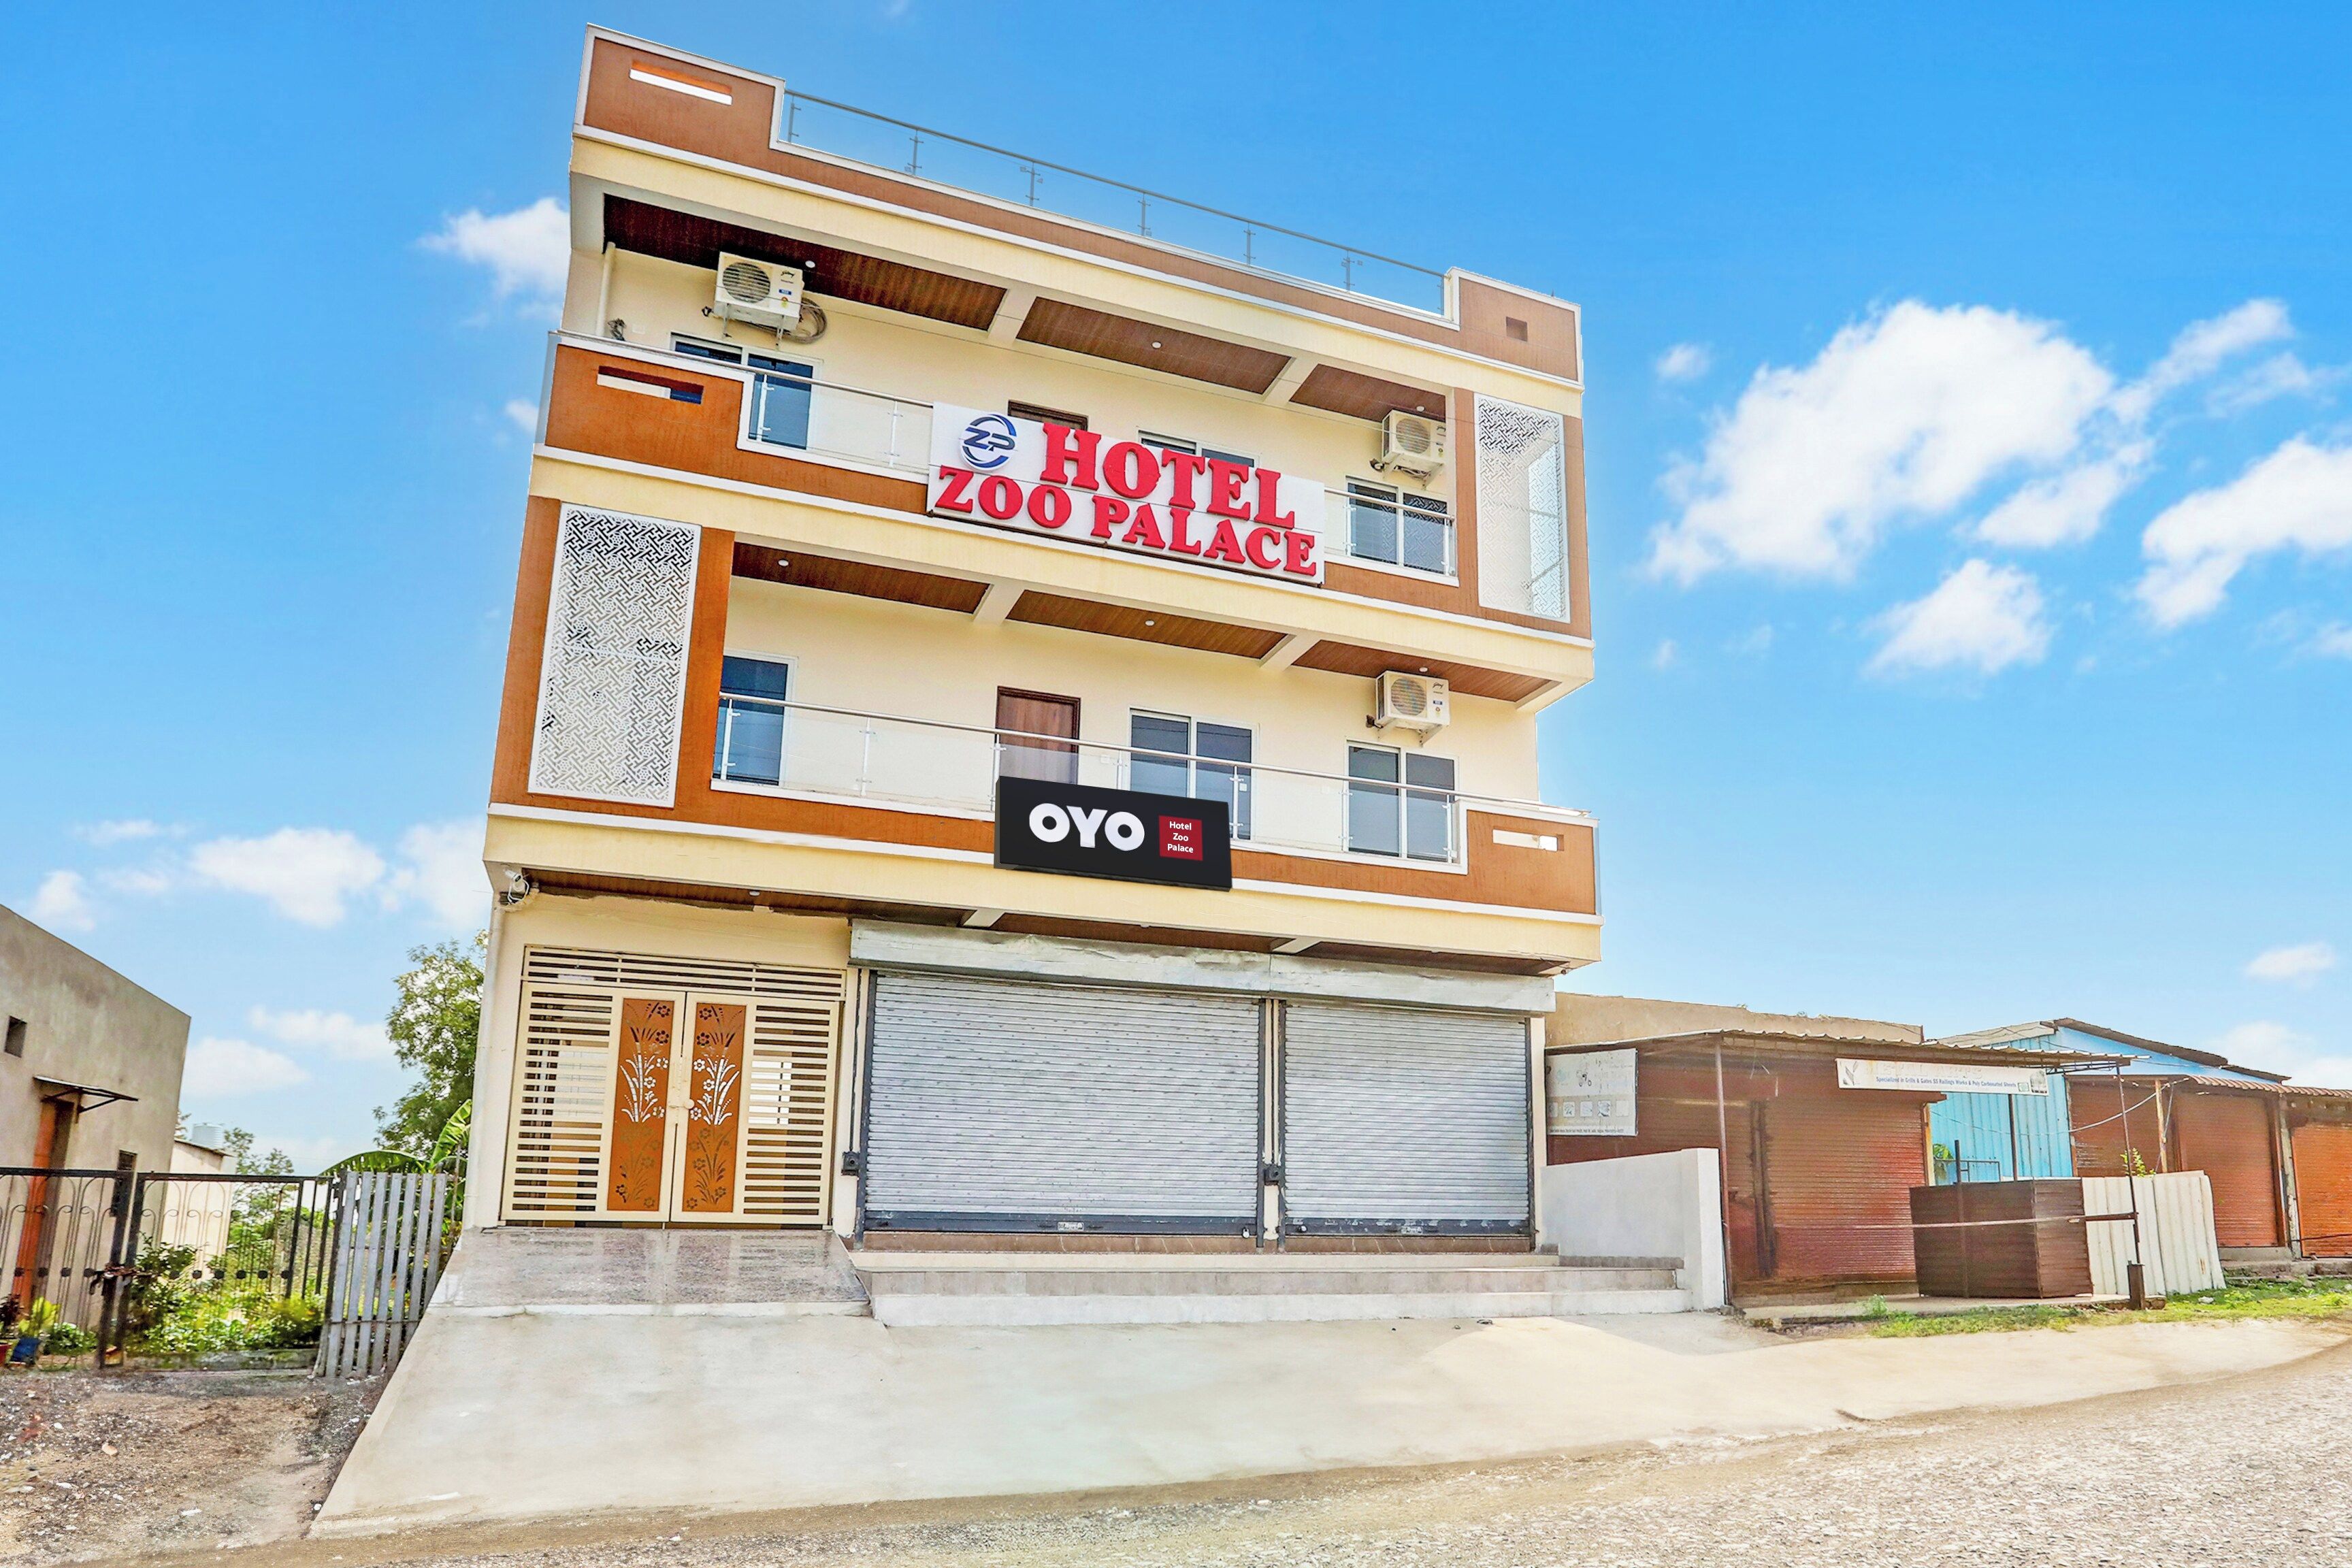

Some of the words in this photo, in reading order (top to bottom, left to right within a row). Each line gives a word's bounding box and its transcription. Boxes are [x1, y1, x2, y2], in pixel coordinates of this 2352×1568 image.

[1040, 422, 1295, 529] HOTEL
[934, 465, 1072, 528] ZOO
[1090, 495, 1316, 576] PALACE
[1029, 802, 1145, 851] OYO
[1169, 821, 1192, 831] Hotel
[1173, 832, 1189, 842] Zoo
[1167, 843, 1194, 853] Palace
